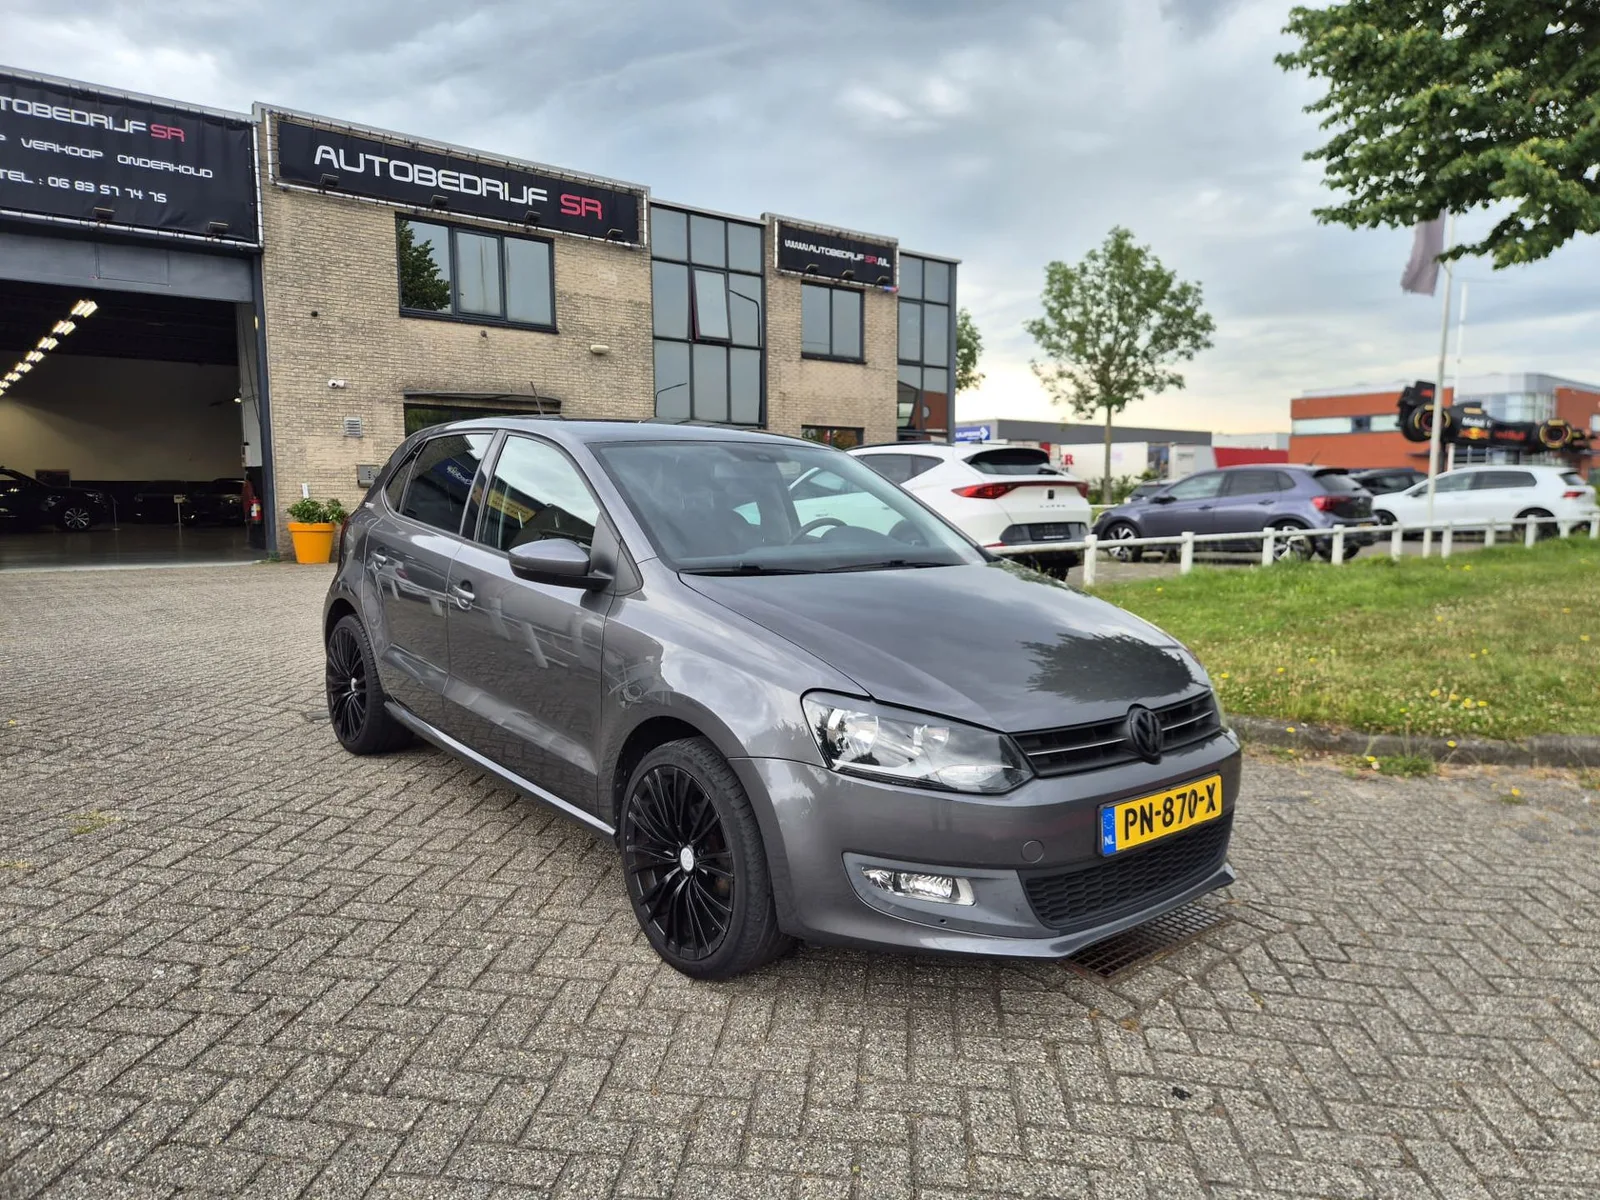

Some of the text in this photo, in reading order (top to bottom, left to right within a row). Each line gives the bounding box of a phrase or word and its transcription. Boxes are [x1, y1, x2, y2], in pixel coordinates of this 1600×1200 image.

[150, 123, 185, 142] SR
[20, 137, 213, 178] VERKOOP ONDERHOUD
[47, 176, 70, 189] 06
[74, 180, 96, 193] 83
[125, 187, 144, 200] 74
[148, 191, 168, 203] 75
[314, 144, 603, 220] AUTOBEDRIJF SR
[1124, 783, 1216, 841] PN-870-X
[1104, 834, 1115, 846] NL
